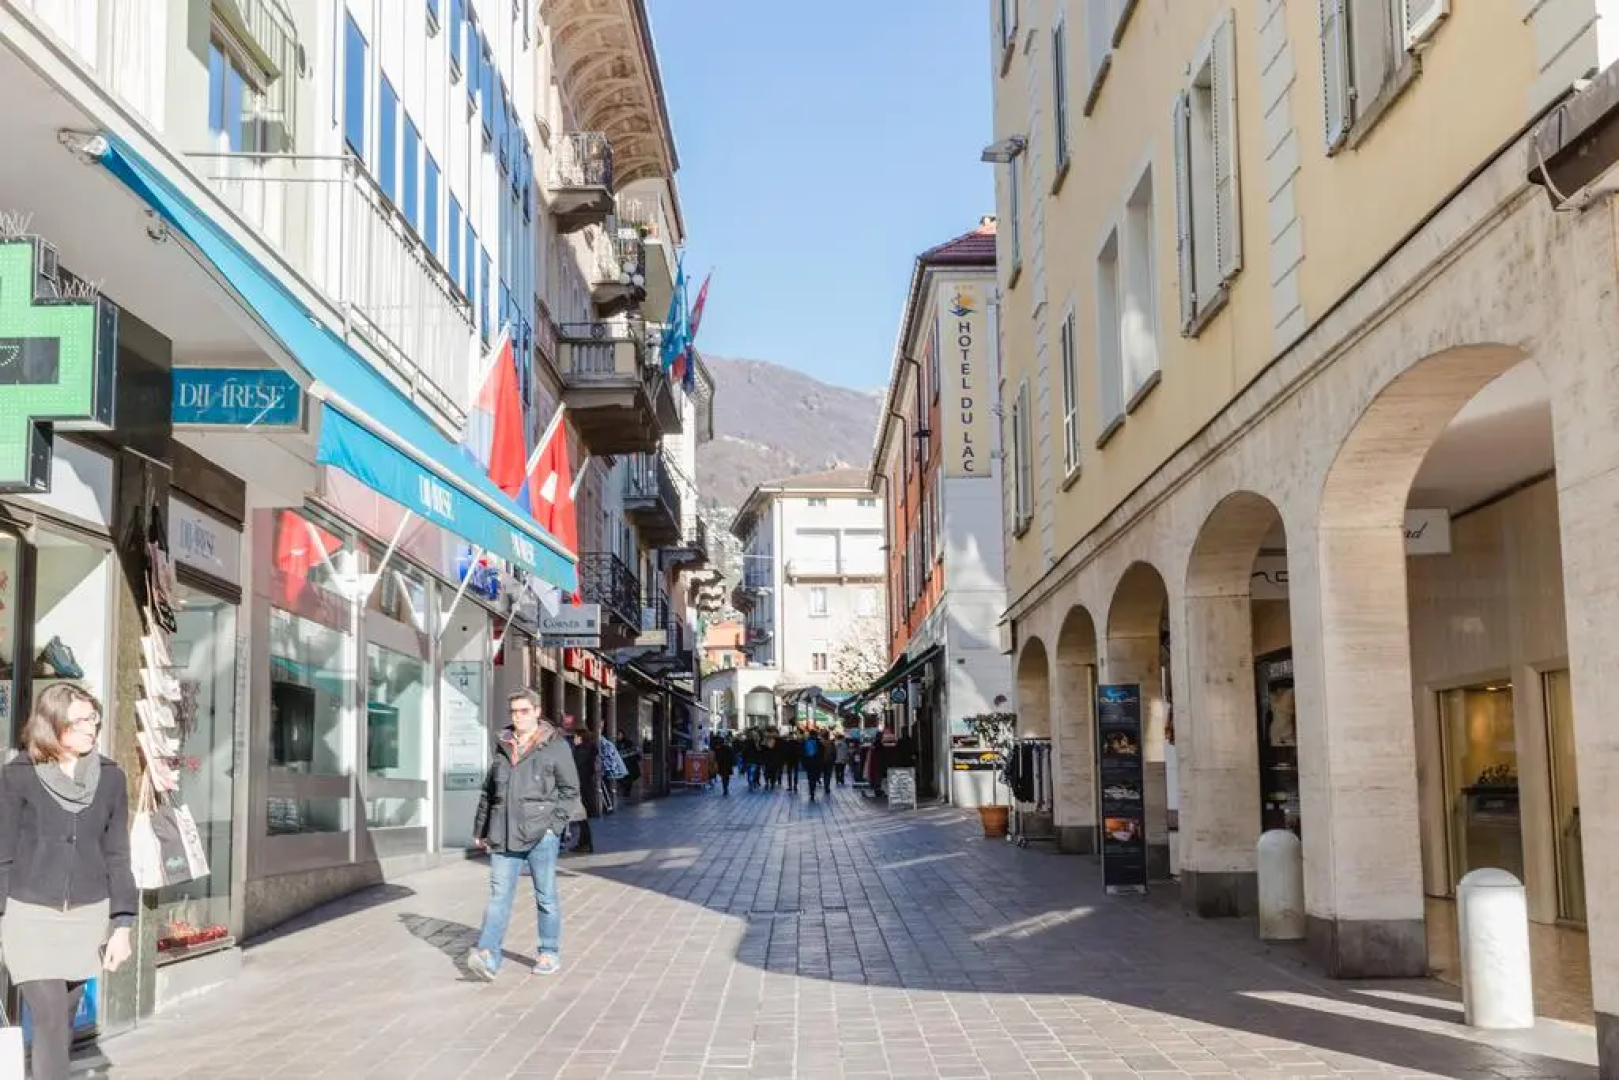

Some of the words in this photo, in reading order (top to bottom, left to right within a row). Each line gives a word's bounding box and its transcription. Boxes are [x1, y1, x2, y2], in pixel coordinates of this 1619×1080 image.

[958, 321, 972, 389] HOTEL
[960, 397, 973, 424] DU
[962, 431, 974, 472] LAC
